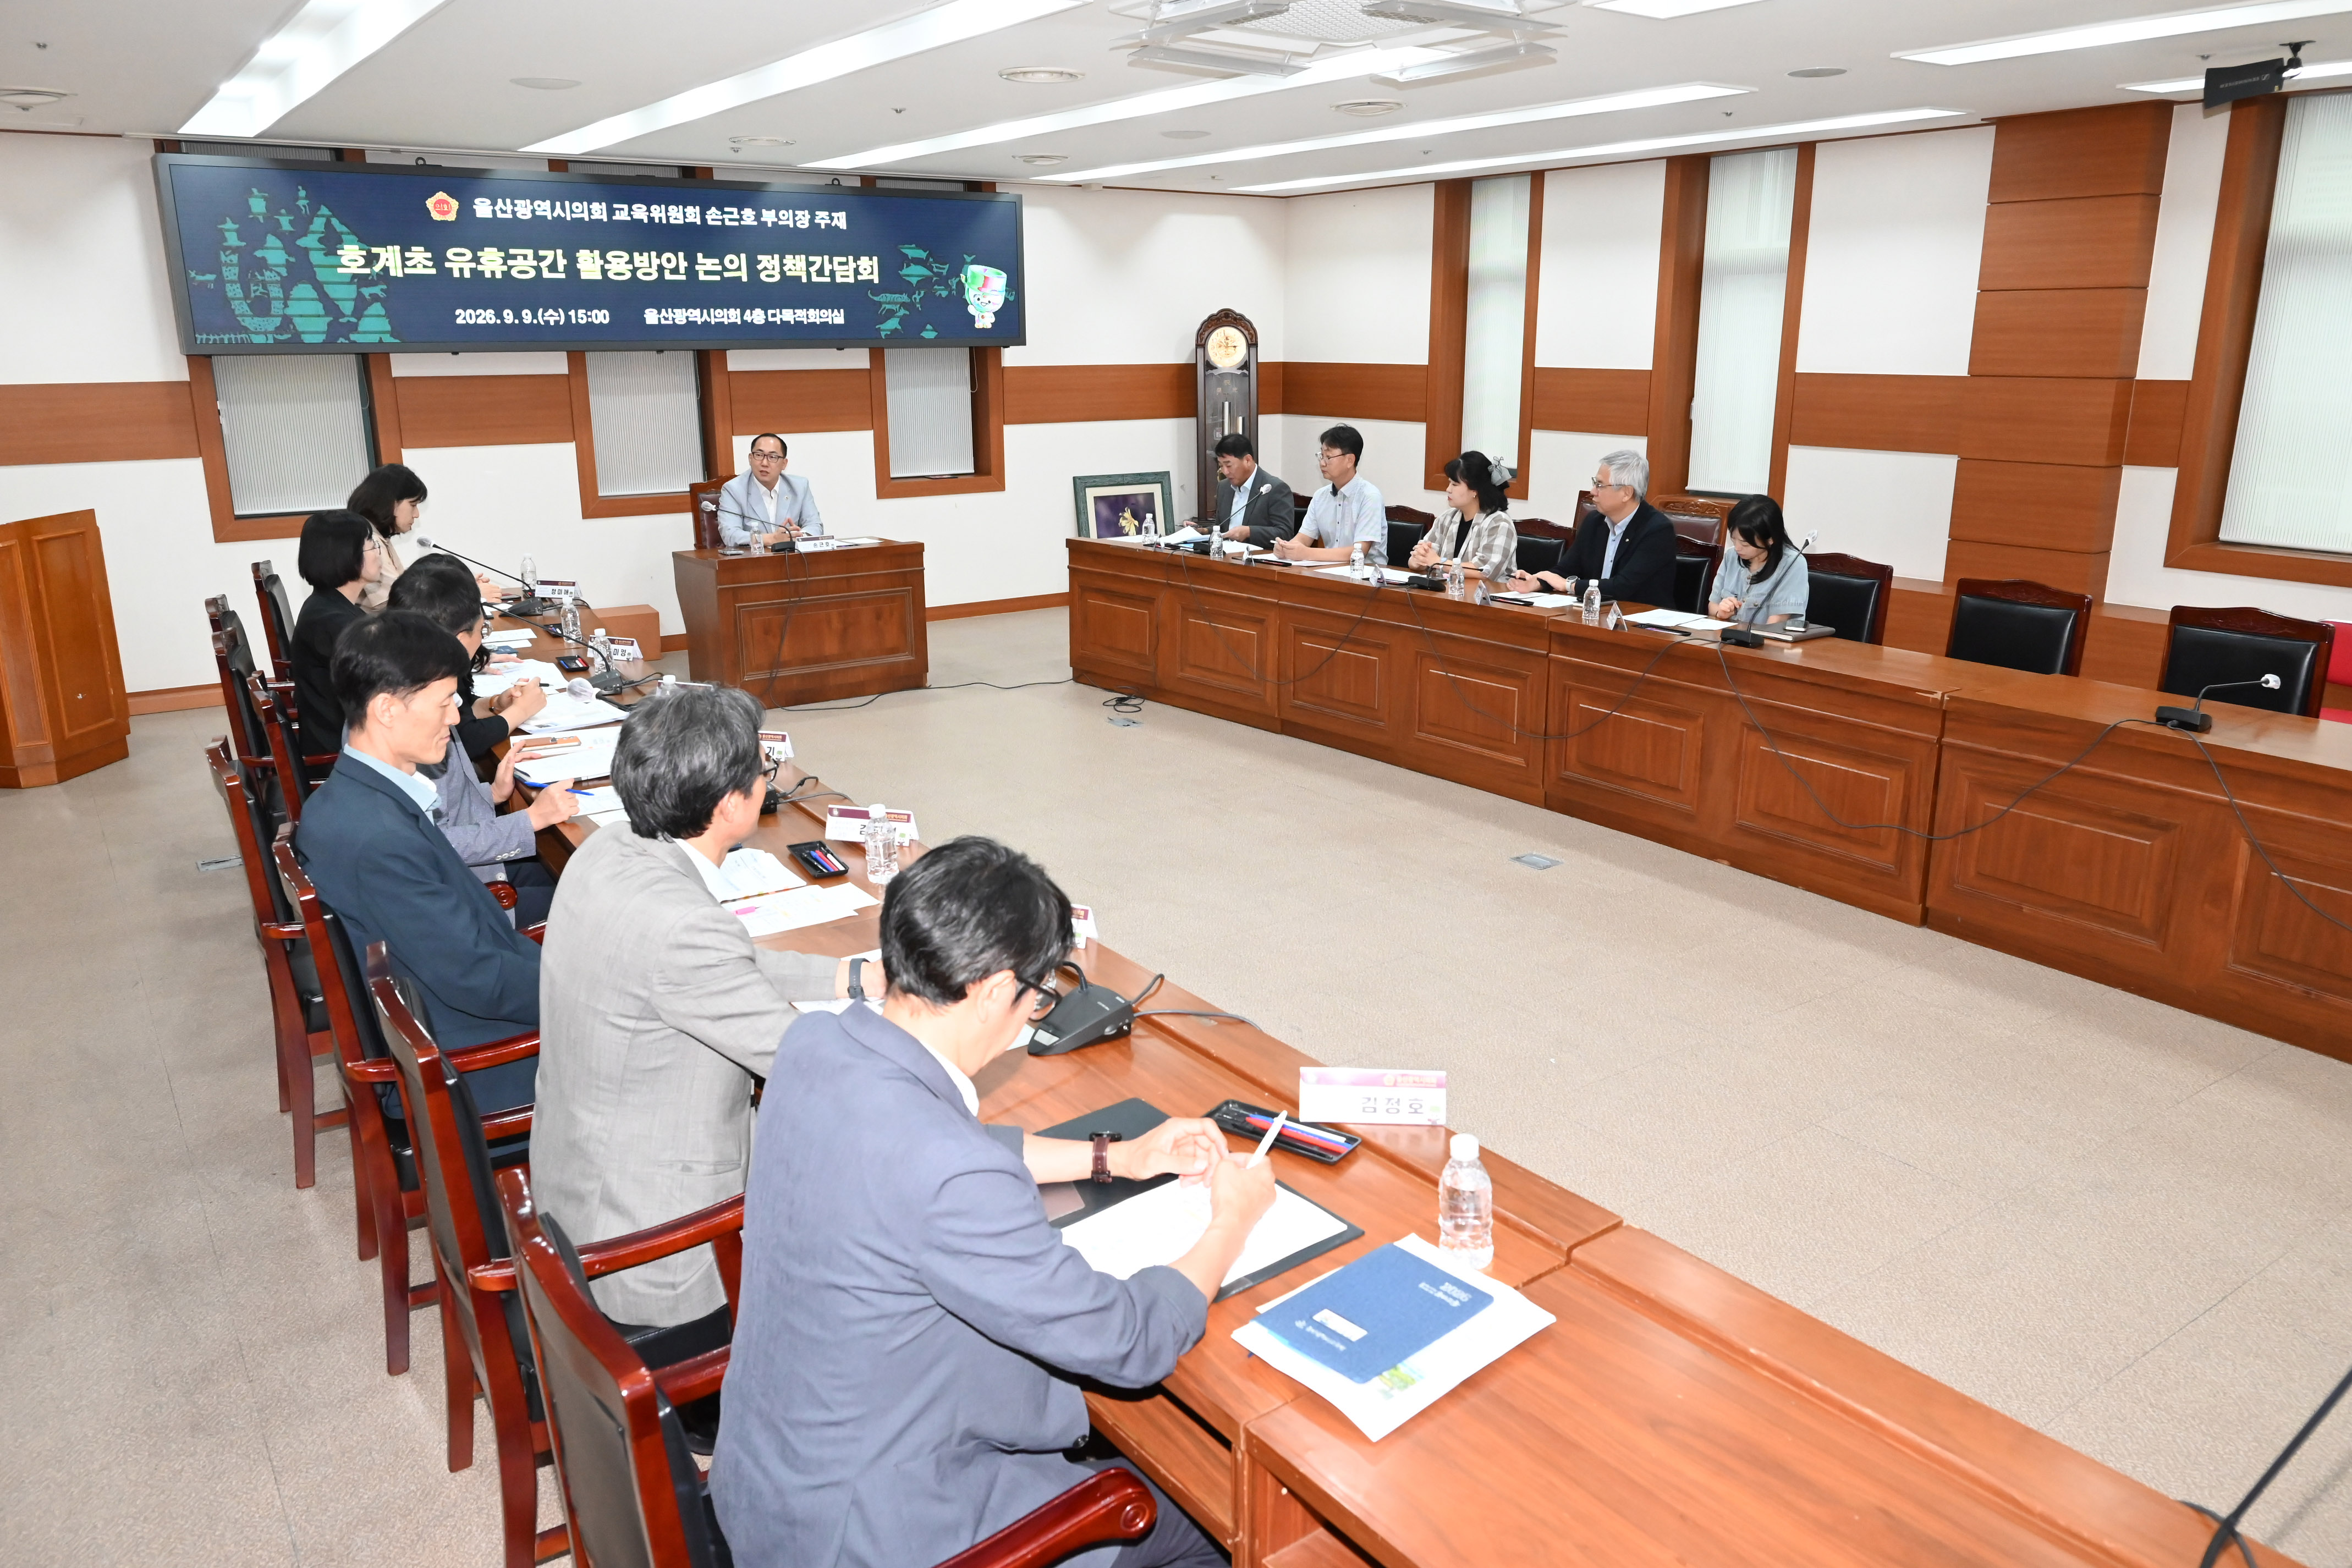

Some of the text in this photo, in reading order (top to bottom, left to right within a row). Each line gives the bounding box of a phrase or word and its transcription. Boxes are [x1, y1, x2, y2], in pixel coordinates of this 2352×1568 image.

[472, 197, 847, 230] 울산광역시의회 교육위원회 손근호 부의장 주재
[337, 244, 879, 284] 호계초 유휴공간 활용방안 논의 정책간담회
[568, 309, 610, 324] 15:00
[644, 308, 845, 325] 울산광역시의회 4층 다목적회의실
[613, 648, 627, 657] 미영
[1361, 1097, 1424, 1114] 김정호
